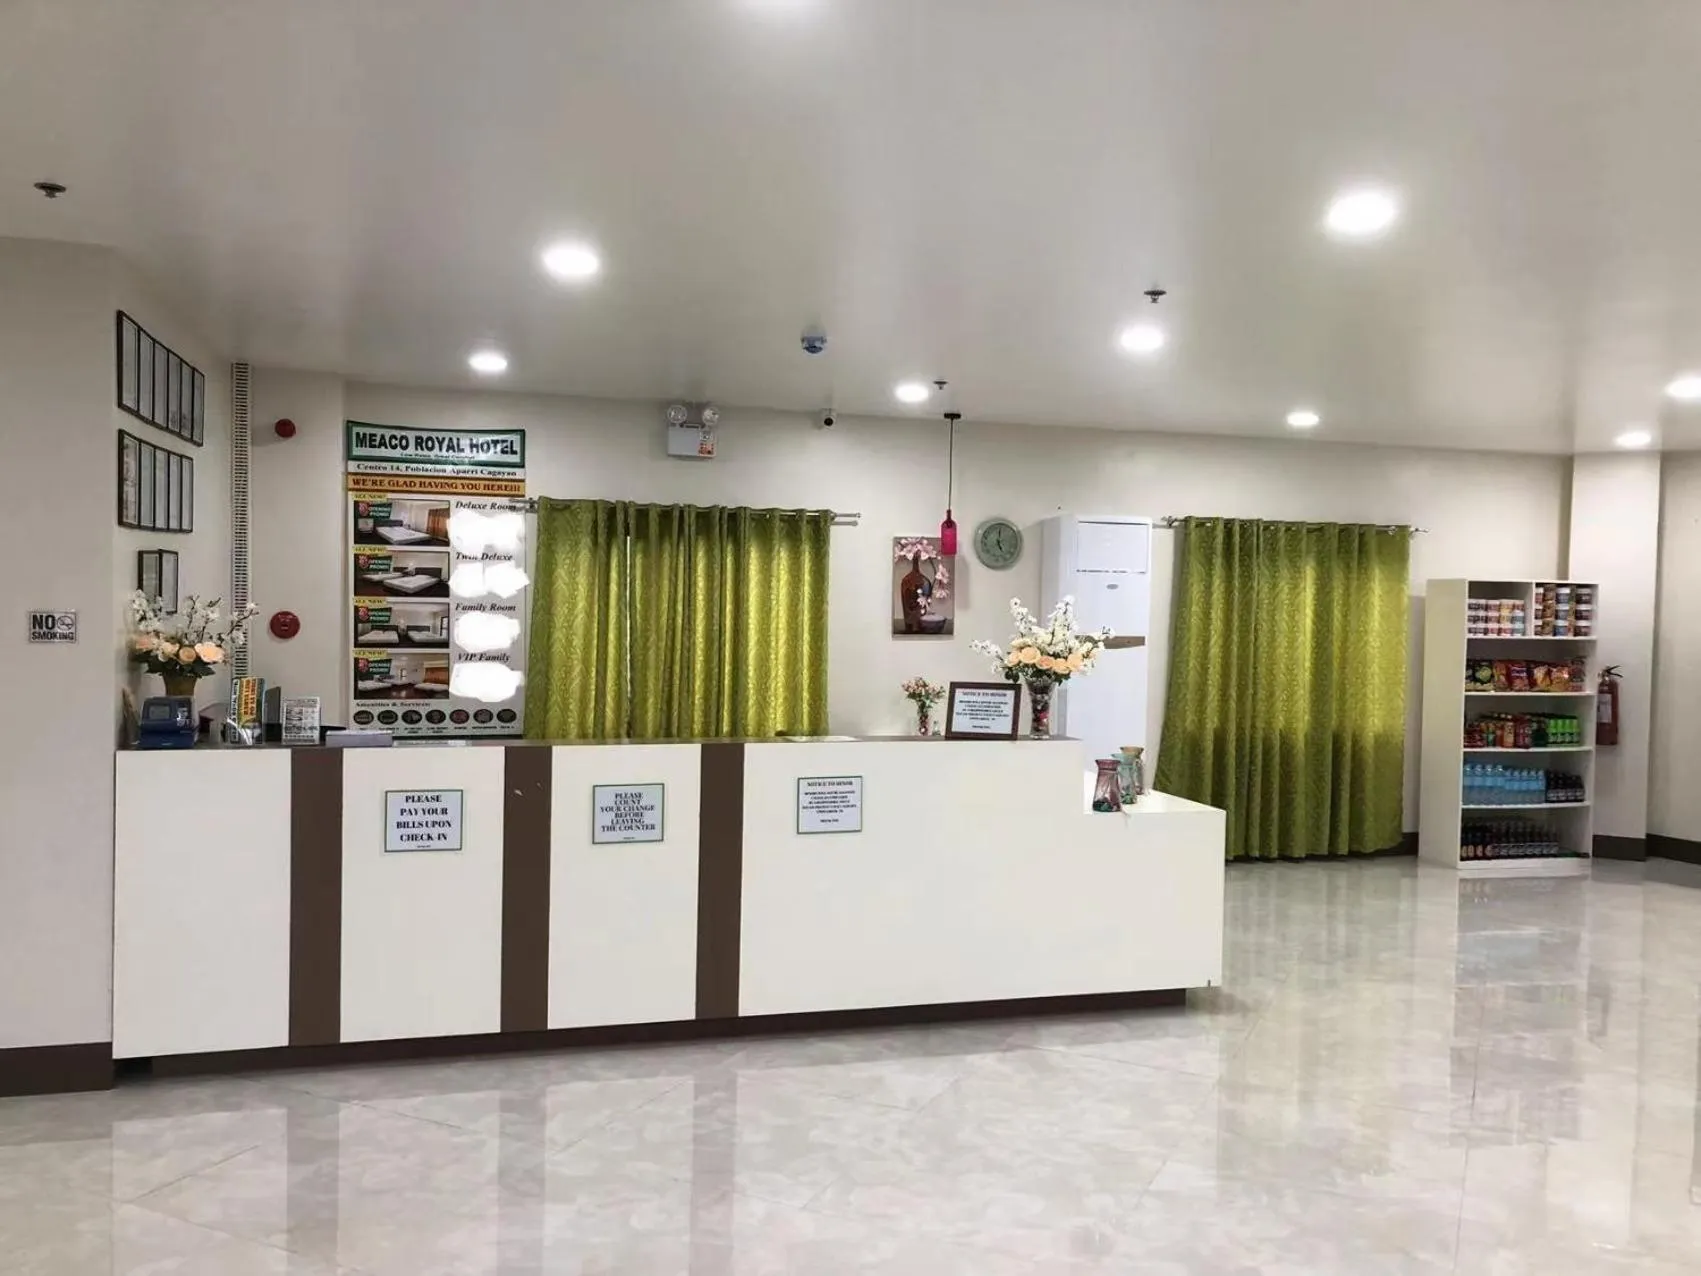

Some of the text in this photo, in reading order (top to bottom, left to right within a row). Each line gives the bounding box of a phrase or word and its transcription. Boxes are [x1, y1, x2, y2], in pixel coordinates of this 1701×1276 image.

[355, 431, 518, 456] MEACO ROYAL HOTEL
[356, 463, 388, 471] Centro
[405, 465, 447, 474] Poblacion
[449, 467, 478, 476] Aparri
[352, 478, 386, 487] WE'RE
[387, 479, 417, 488] GLAD
[418, 480, 458, 490] HAVING
[459, 482, 481, 491] YOU
[455, 501, 517, 510] Deluxe Room
[481, 552, 513, 561] Deluxe
[455, 603, 516, 612] Family Room
[32, 614, 56, 630] NO
[31, 631, 74, 640] SMOKING
[457, 652, 511, 662] VIP Family
[405, 794, 442, 803] PLEASE
[615, 791, 643, 800] PLEASE
[400, 807, 448, 816] PAY YOUR
[600, 804, 655, 813] YOUR CHANGE
[614, 811, 644, 819] BEFORE
[396, 820, 452, 829] BILLS UPON
[618, 823, 656, 831] COUNTER
[400, 832, 448, 842] CHECK IN
